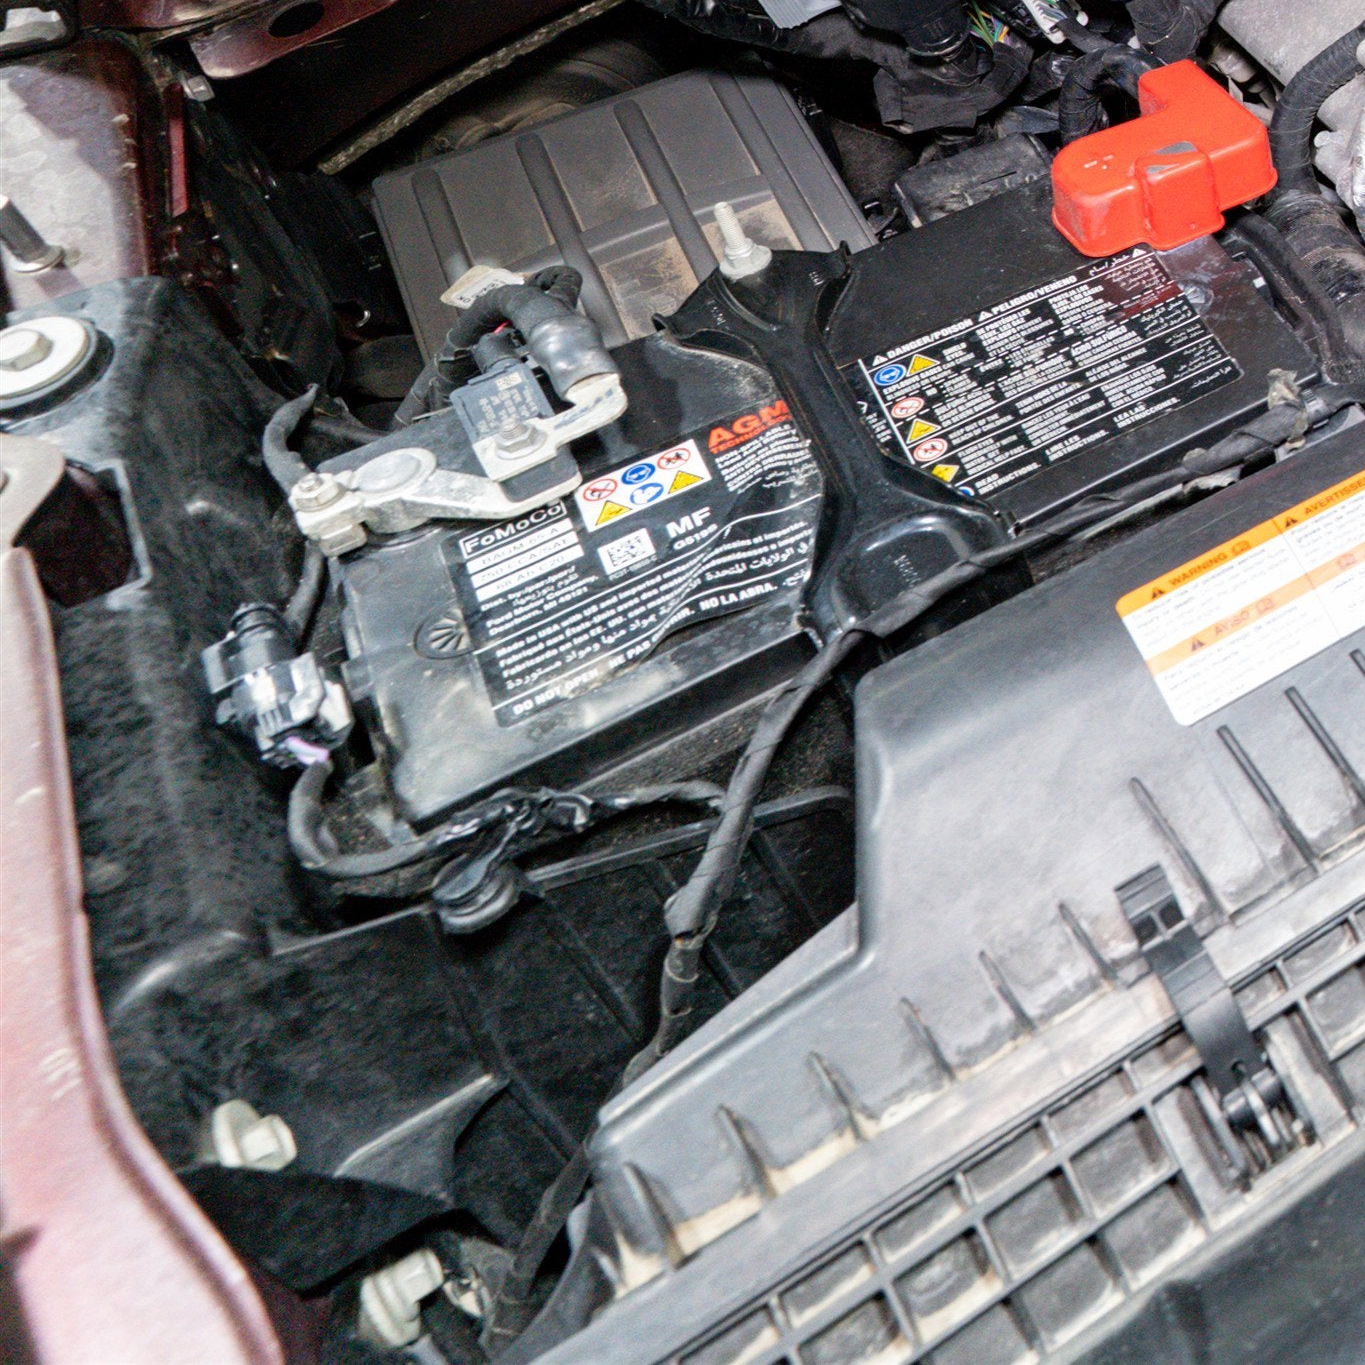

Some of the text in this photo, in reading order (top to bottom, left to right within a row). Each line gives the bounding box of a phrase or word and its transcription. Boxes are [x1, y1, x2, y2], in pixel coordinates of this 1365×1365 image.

[990, 272, 1078, 317] PELIGRO/VENENO
[885, 316, 974, 361] DANGER/POISON
[1068, 341, 1092, 356] ÁCIDO
[1089, 324, 1128, 347] SULFÚRICO
[704, 396, 790, 449] AGM
[1112, 403, 1146, 423] LEA LAS
[1116, 394, 1181, 429] INSTRUCCIONES.
[1044, 434, 1081, 455] LIRE LES
[1047, 428, 1110, 462] INSTRUCTIONS.
[973, 472, 1000, 488] READ
[976, 460, 1042, 495] INSTRUCTIONS.
[463, 499, 562, 554] FoMoCo
[664, 504, 714, 539] MF
[1167, 550, 1229, 588] WARNING
[698, 594, 719, 613] NO
[719, 588, 739, 608] LA
[737, 573, 778, 606] ABRA.
[1211, 608, 1252, 637] AVISO
[512, 665, 599, 717] DO NOT OPEN
